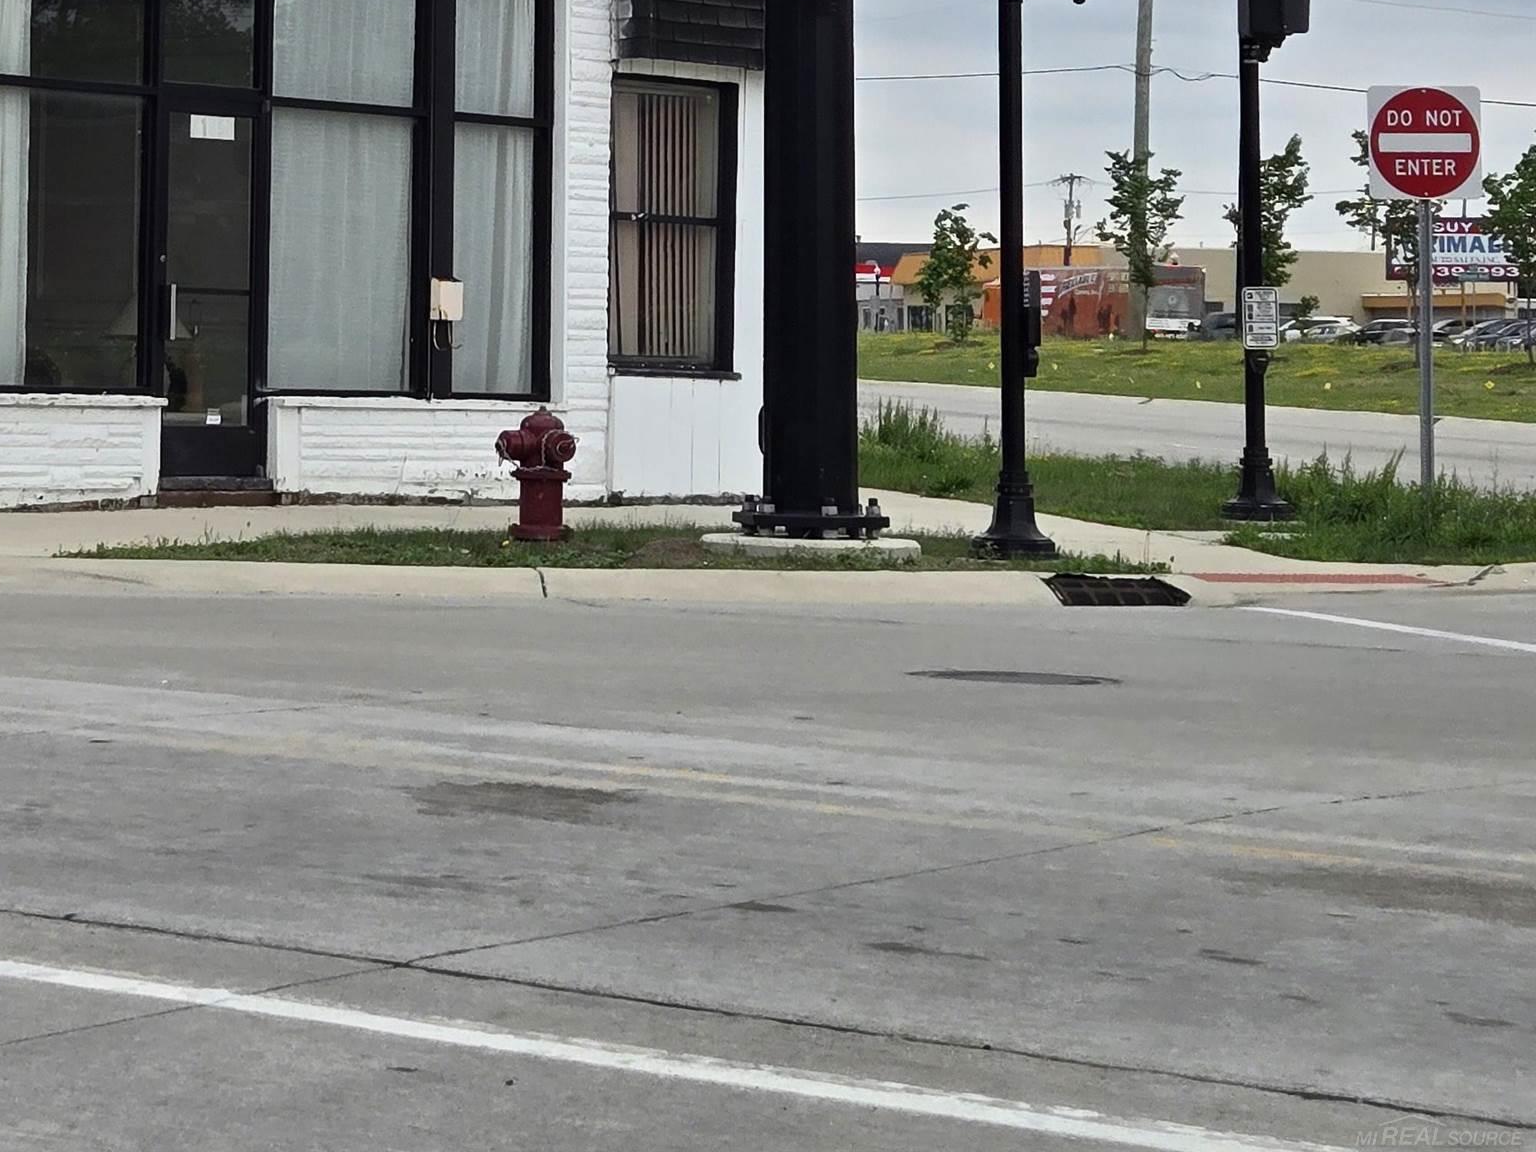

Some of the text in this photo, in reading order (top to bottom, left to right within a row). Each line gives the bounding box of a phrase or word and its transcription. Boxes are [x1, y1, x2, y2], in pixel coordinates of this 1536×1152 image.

[1387, 110, 1463, 126] DO NOT
[1395, 159, 1456, 176] ENTER
